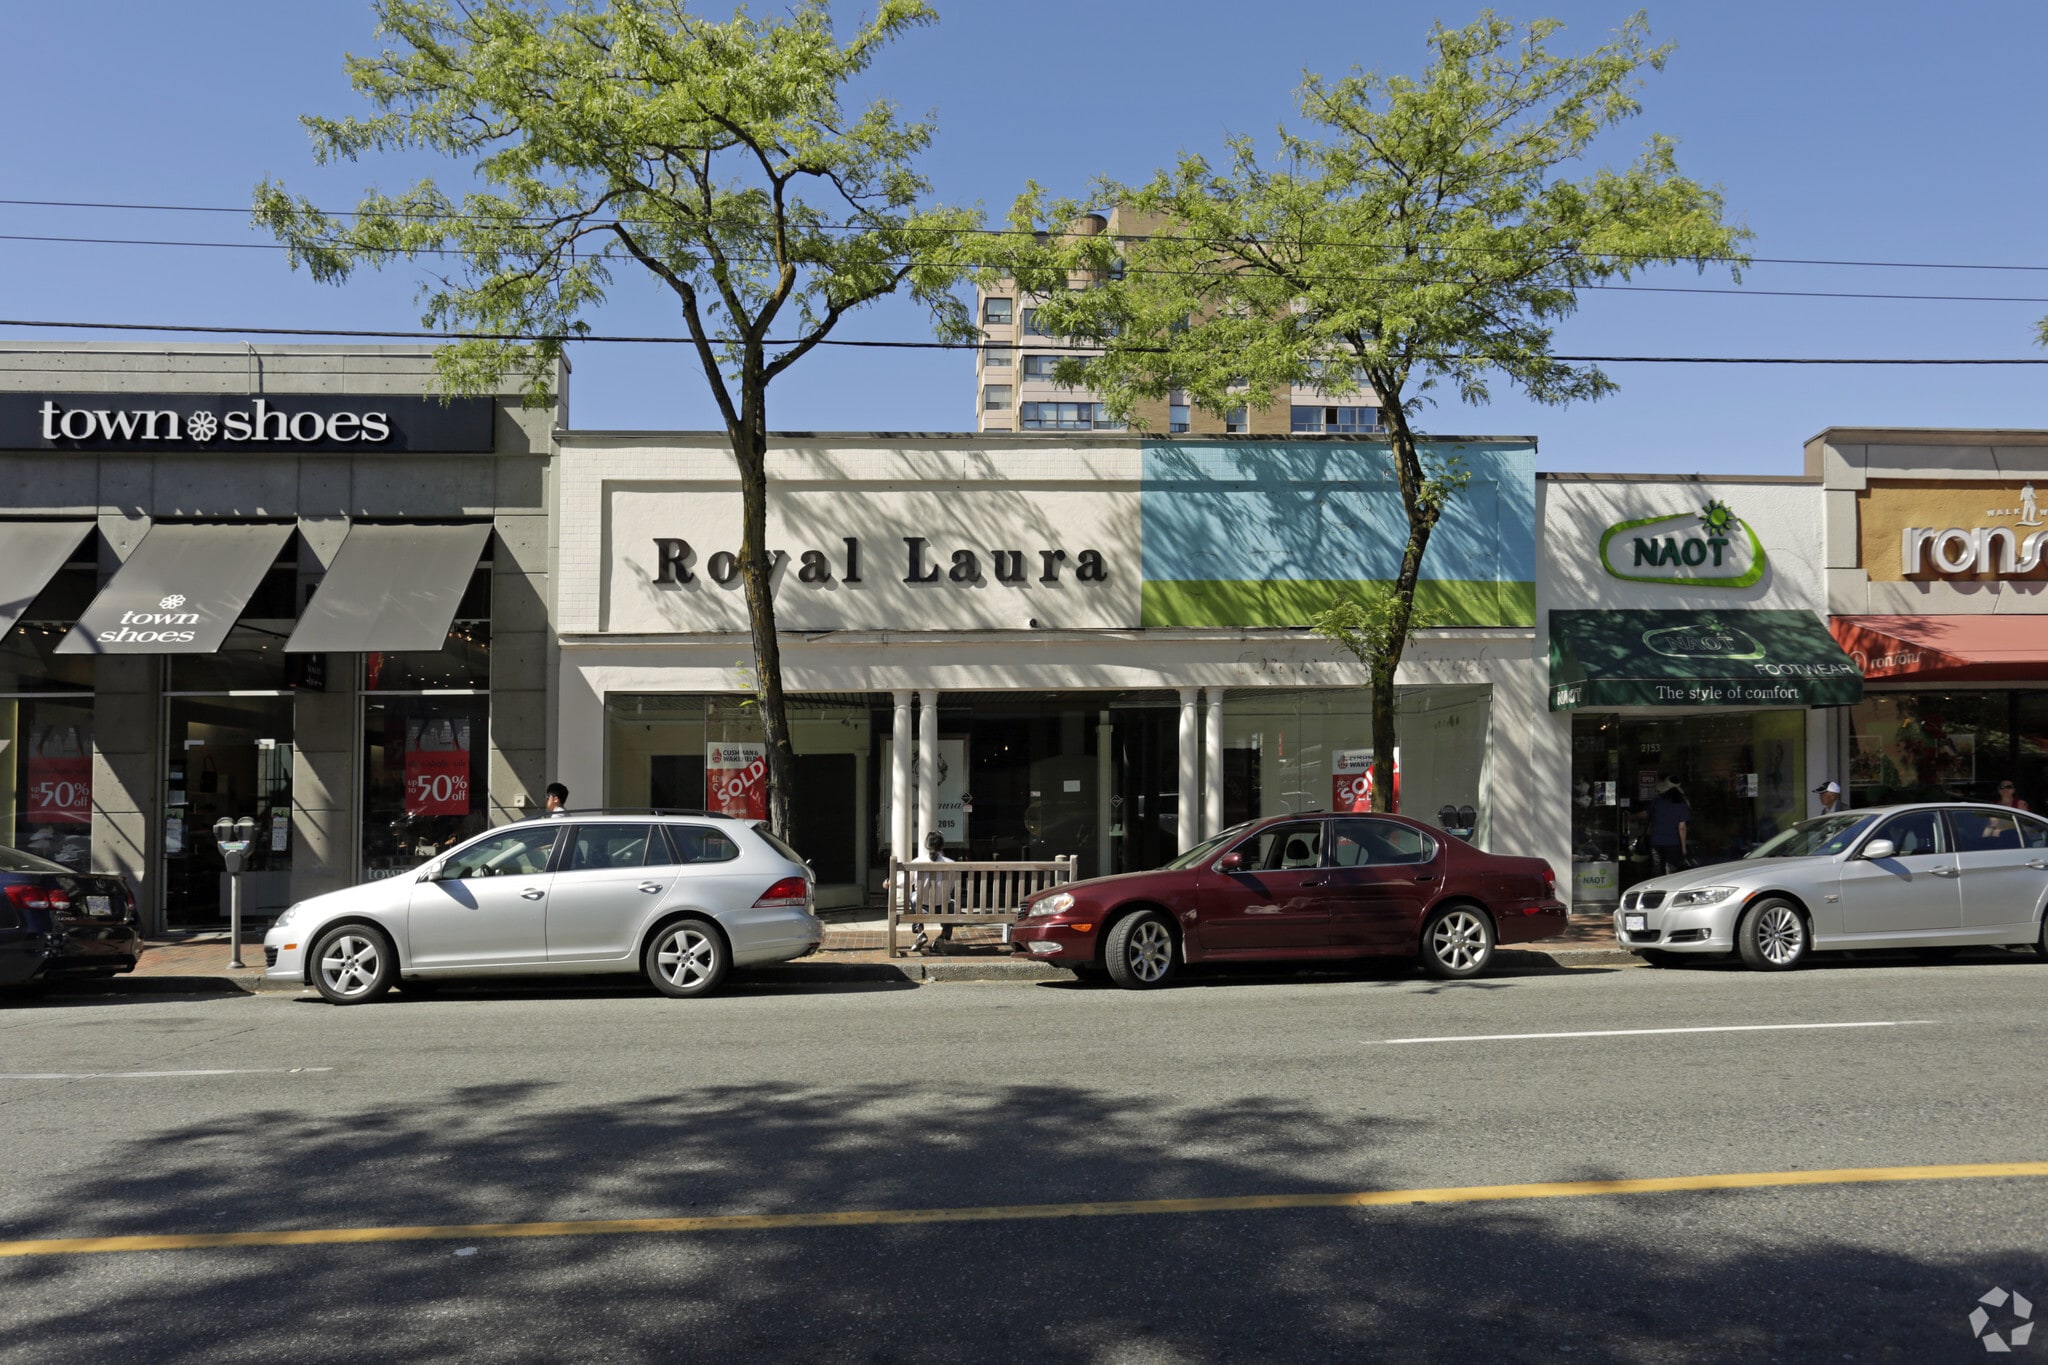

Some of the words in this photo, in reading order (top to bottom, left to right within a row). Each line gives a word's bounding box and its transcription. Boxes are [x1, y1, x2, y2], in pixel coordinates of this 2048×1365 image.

[39, 400, 183, 441] town
[223, 399, 390, 442] shoes
[1986, 508, 2021, 517] WALK
[903, 537, 1108, 583] Laura
[1634, 538, 1729, 567] NAOT
[120, 610, 200, 625] town
[97, 627, 195, 643] shoes
[1664, 636, 1735, 651] NAOT
[1870, 651, 1920, 669] ronsons
[1754, 663, 1855, 675] FOOTWEAR
[1557, 688, 1582, 706] NAOT
[1655, 685, 1684, 699] The
[1689, 686, 1722, 702] style
[1728, 685, 1741, 699] of
[1745, 685, 1800, 700] comfort
[1641, 743, 1661, 752] 2153
[717, 760, 764, 806] SOLD
[74, 796, 88, 807] off
[452, 790, 466, 801] off
[938, 820, 955, 828] 2015
[1583, 876, 1606, 884] NAOT
